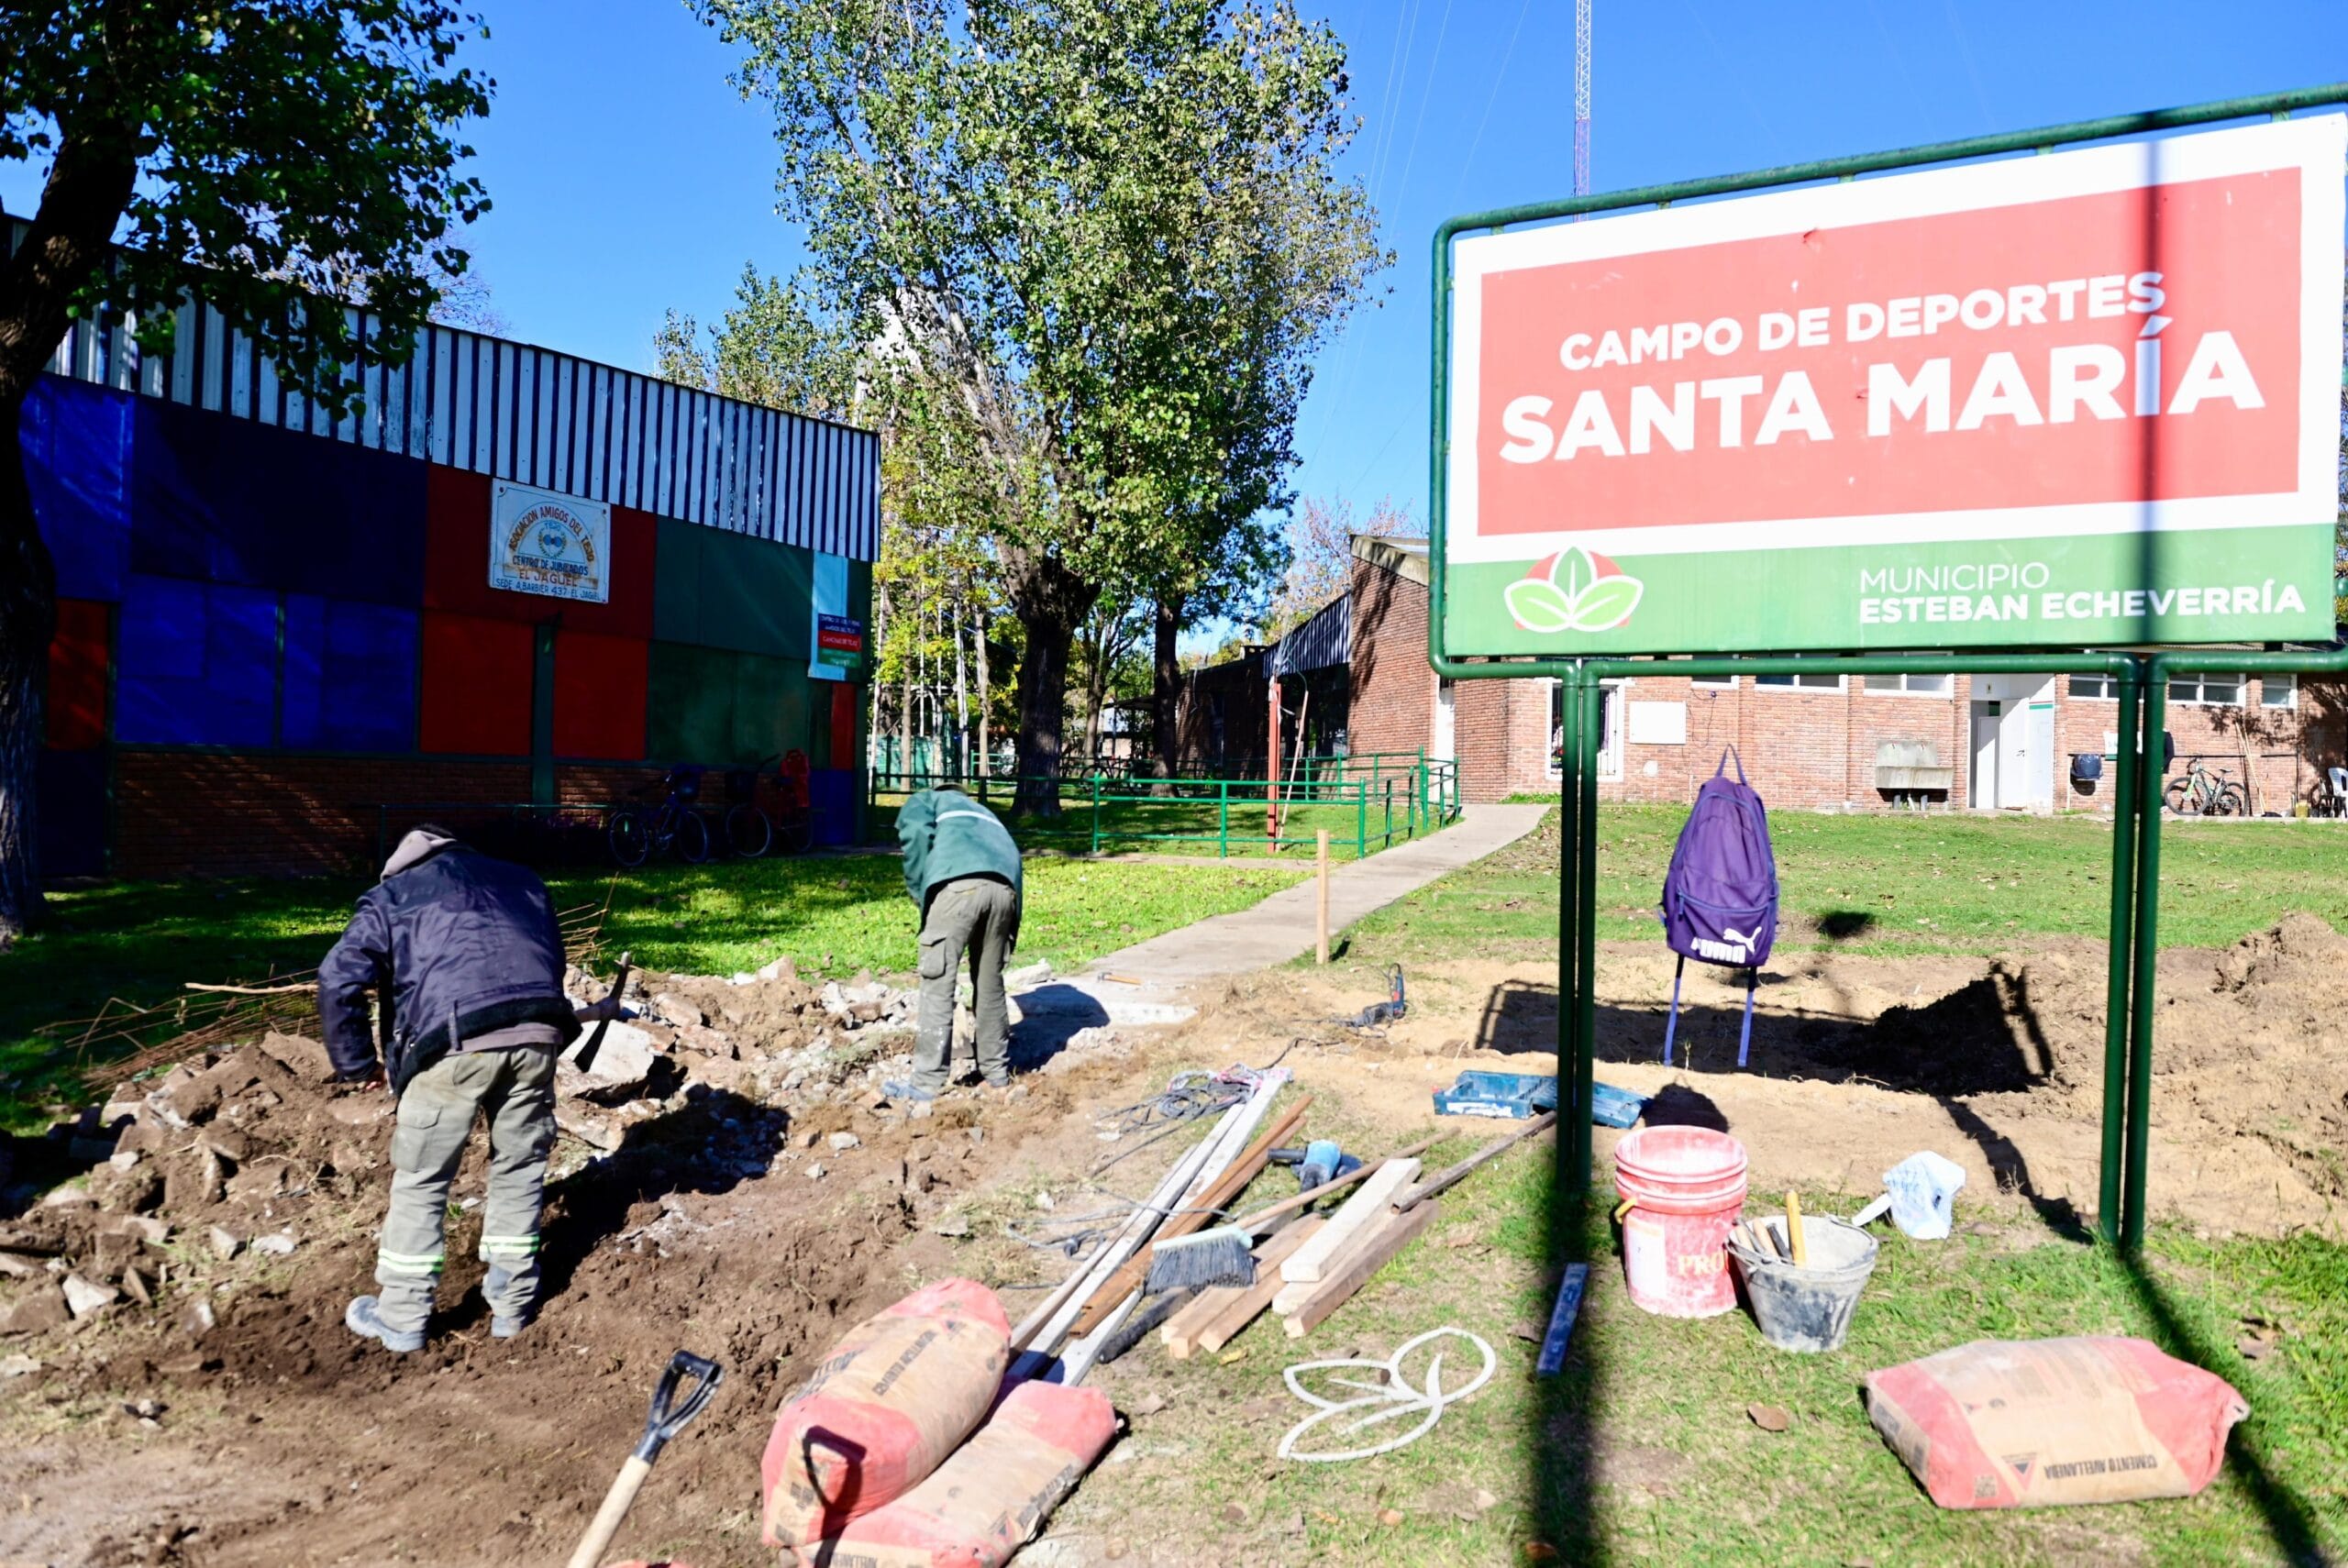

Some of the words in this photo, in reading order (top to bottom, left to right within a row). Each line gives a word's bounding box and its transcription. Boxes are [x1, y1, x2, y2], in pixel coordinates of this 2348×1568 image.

[1559, 315, 1744, 371] CAMPO
[1757, 305, 1832, 352] DE
[1845, 272, 2166, 343] DEPORTES
[1499, 370, 1834, 464] SANTA
[1866, 315, 2267, 438] MARÍA
[539, 505, 569, 524] AMIGOS
[569, 518, 583, 537] DEL
[513, 555, 539, 569] CENTRO
[540, 559, 549, 569] DE
[519, 569, 530, 580] EL
[1859, 561, 2050, 595] MUNICIPIO
[495, 578, 513, 589] SEDE
[551, 587, 567, 596] 437
[1859, 593, 2030, 626] ESTEBAN
[2041, 577, 2308, 620] ECHEVERRÍA
[2108, 1454, 2158, 1473] CEMENTO
